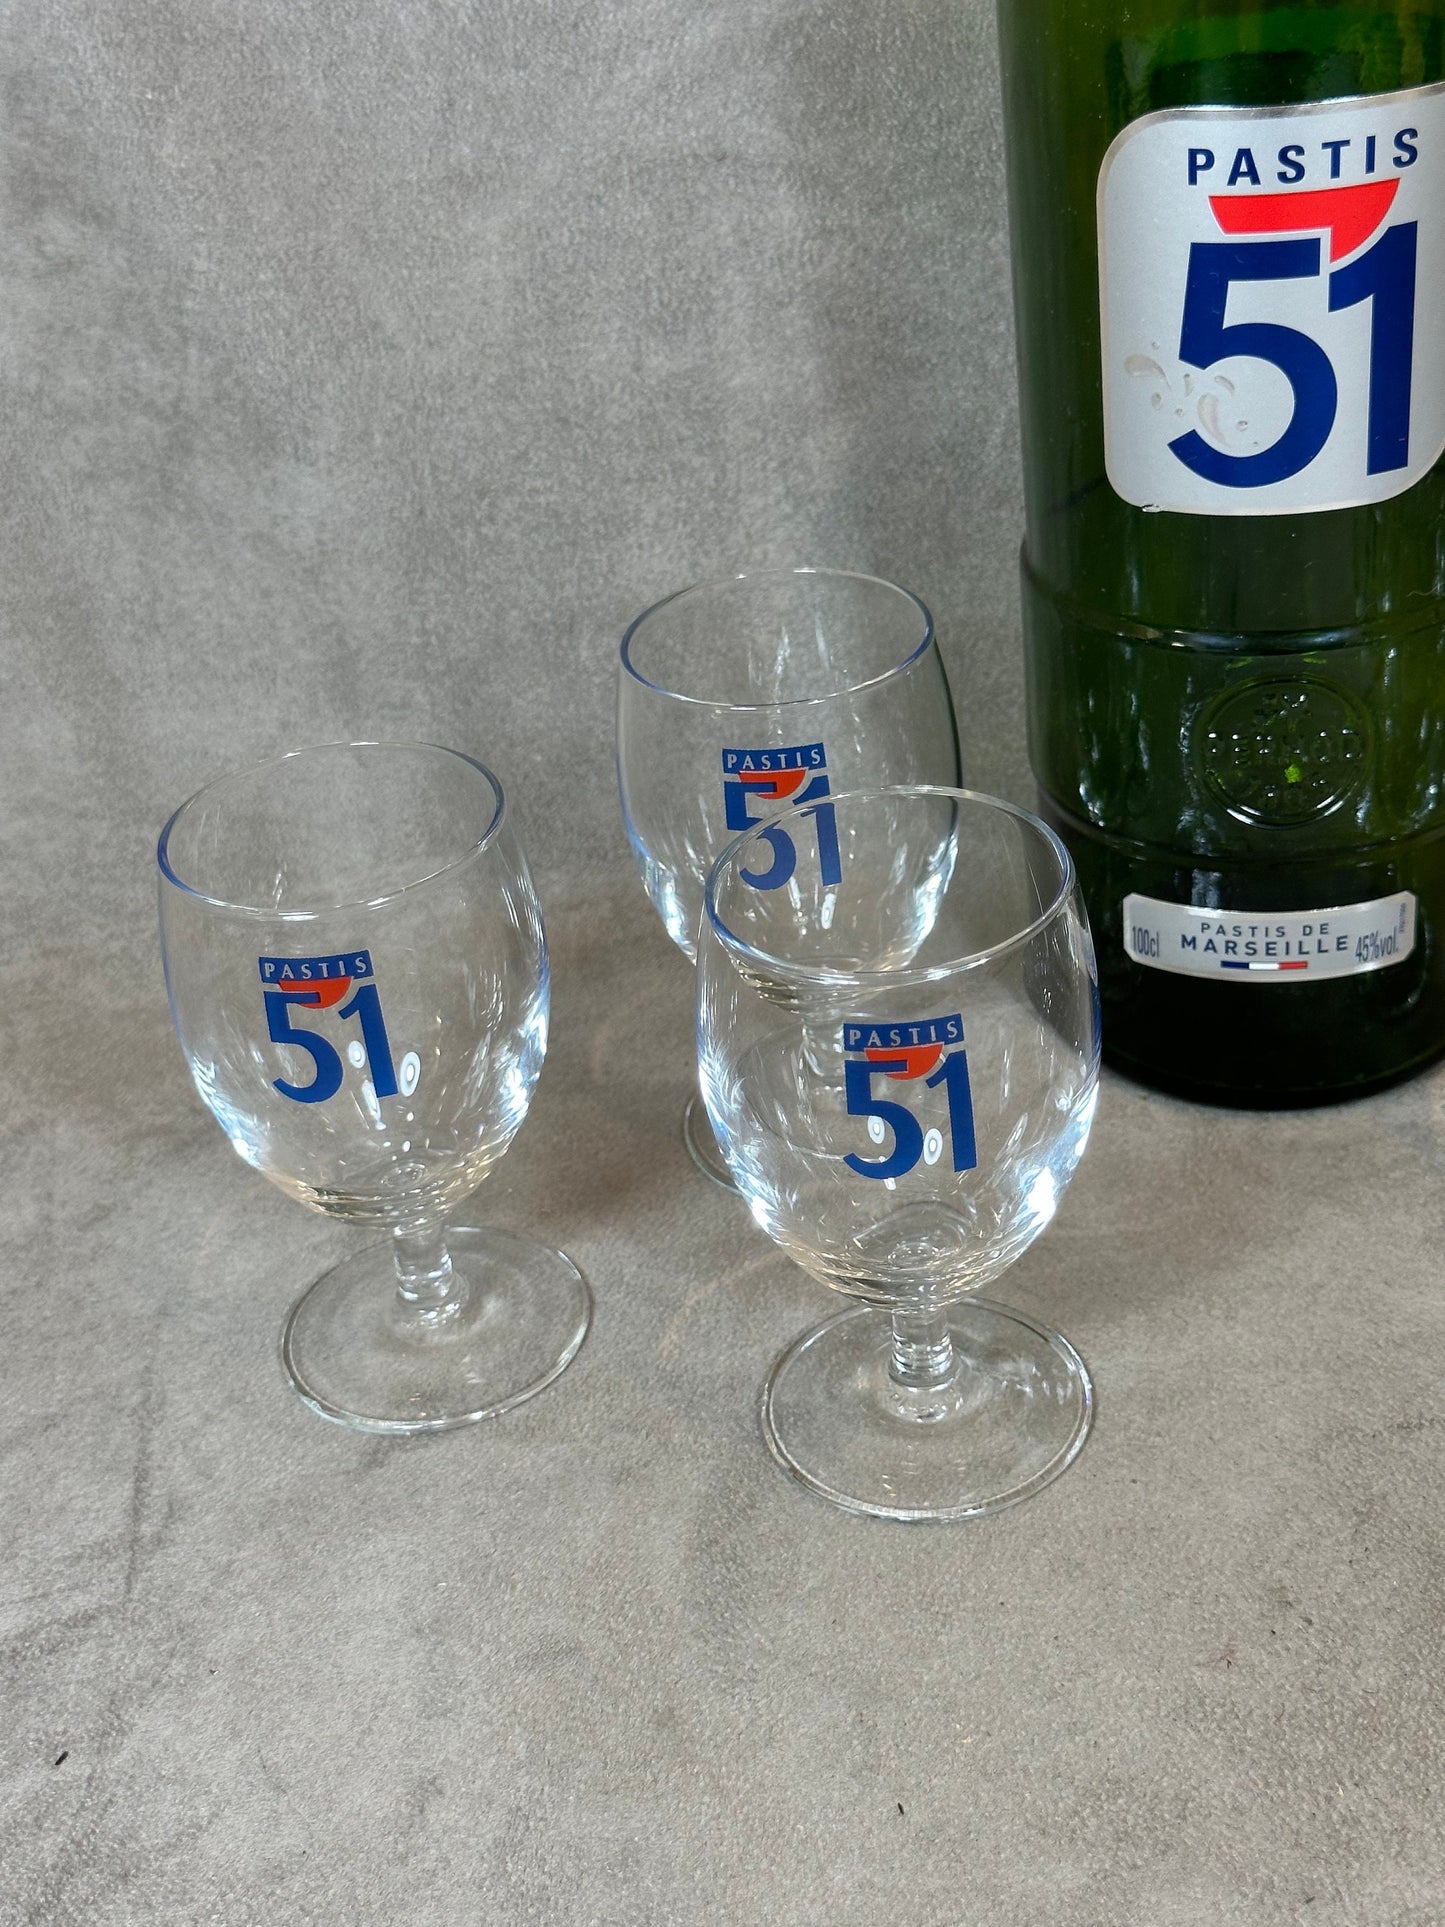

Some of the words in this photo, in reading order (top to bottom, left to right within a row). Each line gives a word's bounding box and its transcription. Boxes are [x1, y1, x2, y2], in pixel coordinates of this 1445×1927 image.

[1187, 128, 1419, 186] PASTIS
[1167, 220, 1418, 488] 51
[727, 749, 821, 770] PASTIS
[723, 775, 843, 891] 51
[1131, 924, 1160, 959] 100cl
[1180, 934, 1349, 957] MARSEILLE
[1200, 922, 1286, 938] PASTIS
[1302, 922, 1330, 937] DE
[264, 956, 368, 979] PASTIS
[263, 983, 399, 1104] 51
[849, 1020, 958, 1047] PASTIS
[842, 1049, 978, 1180] 51
